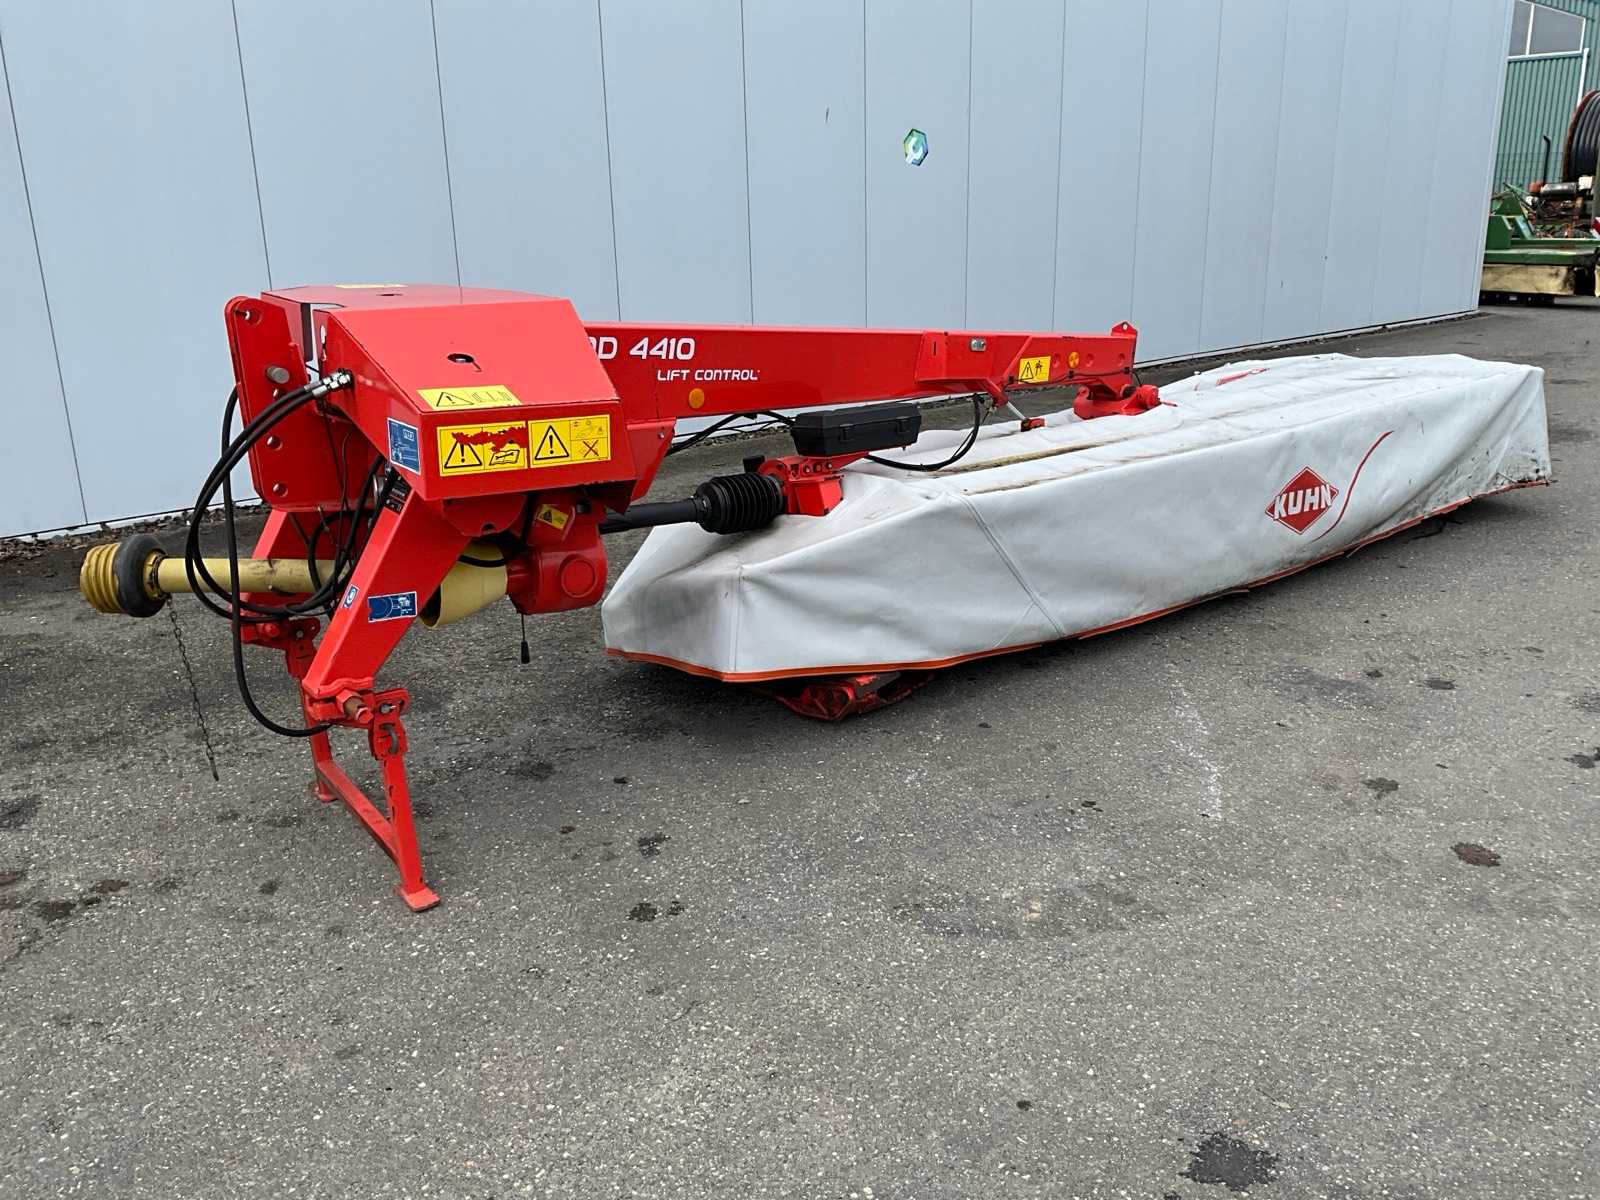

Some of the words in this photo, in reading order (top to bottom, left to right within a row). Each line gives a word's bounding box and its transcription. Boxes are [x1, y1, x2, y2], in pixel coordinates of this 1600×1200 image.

[629, 337, 695, 360] 4410
[657, 369, 690, 381] LIFT
[694, 369, 758, 381] CONTROL
[1273, 484, 1332, 520] KUHN
